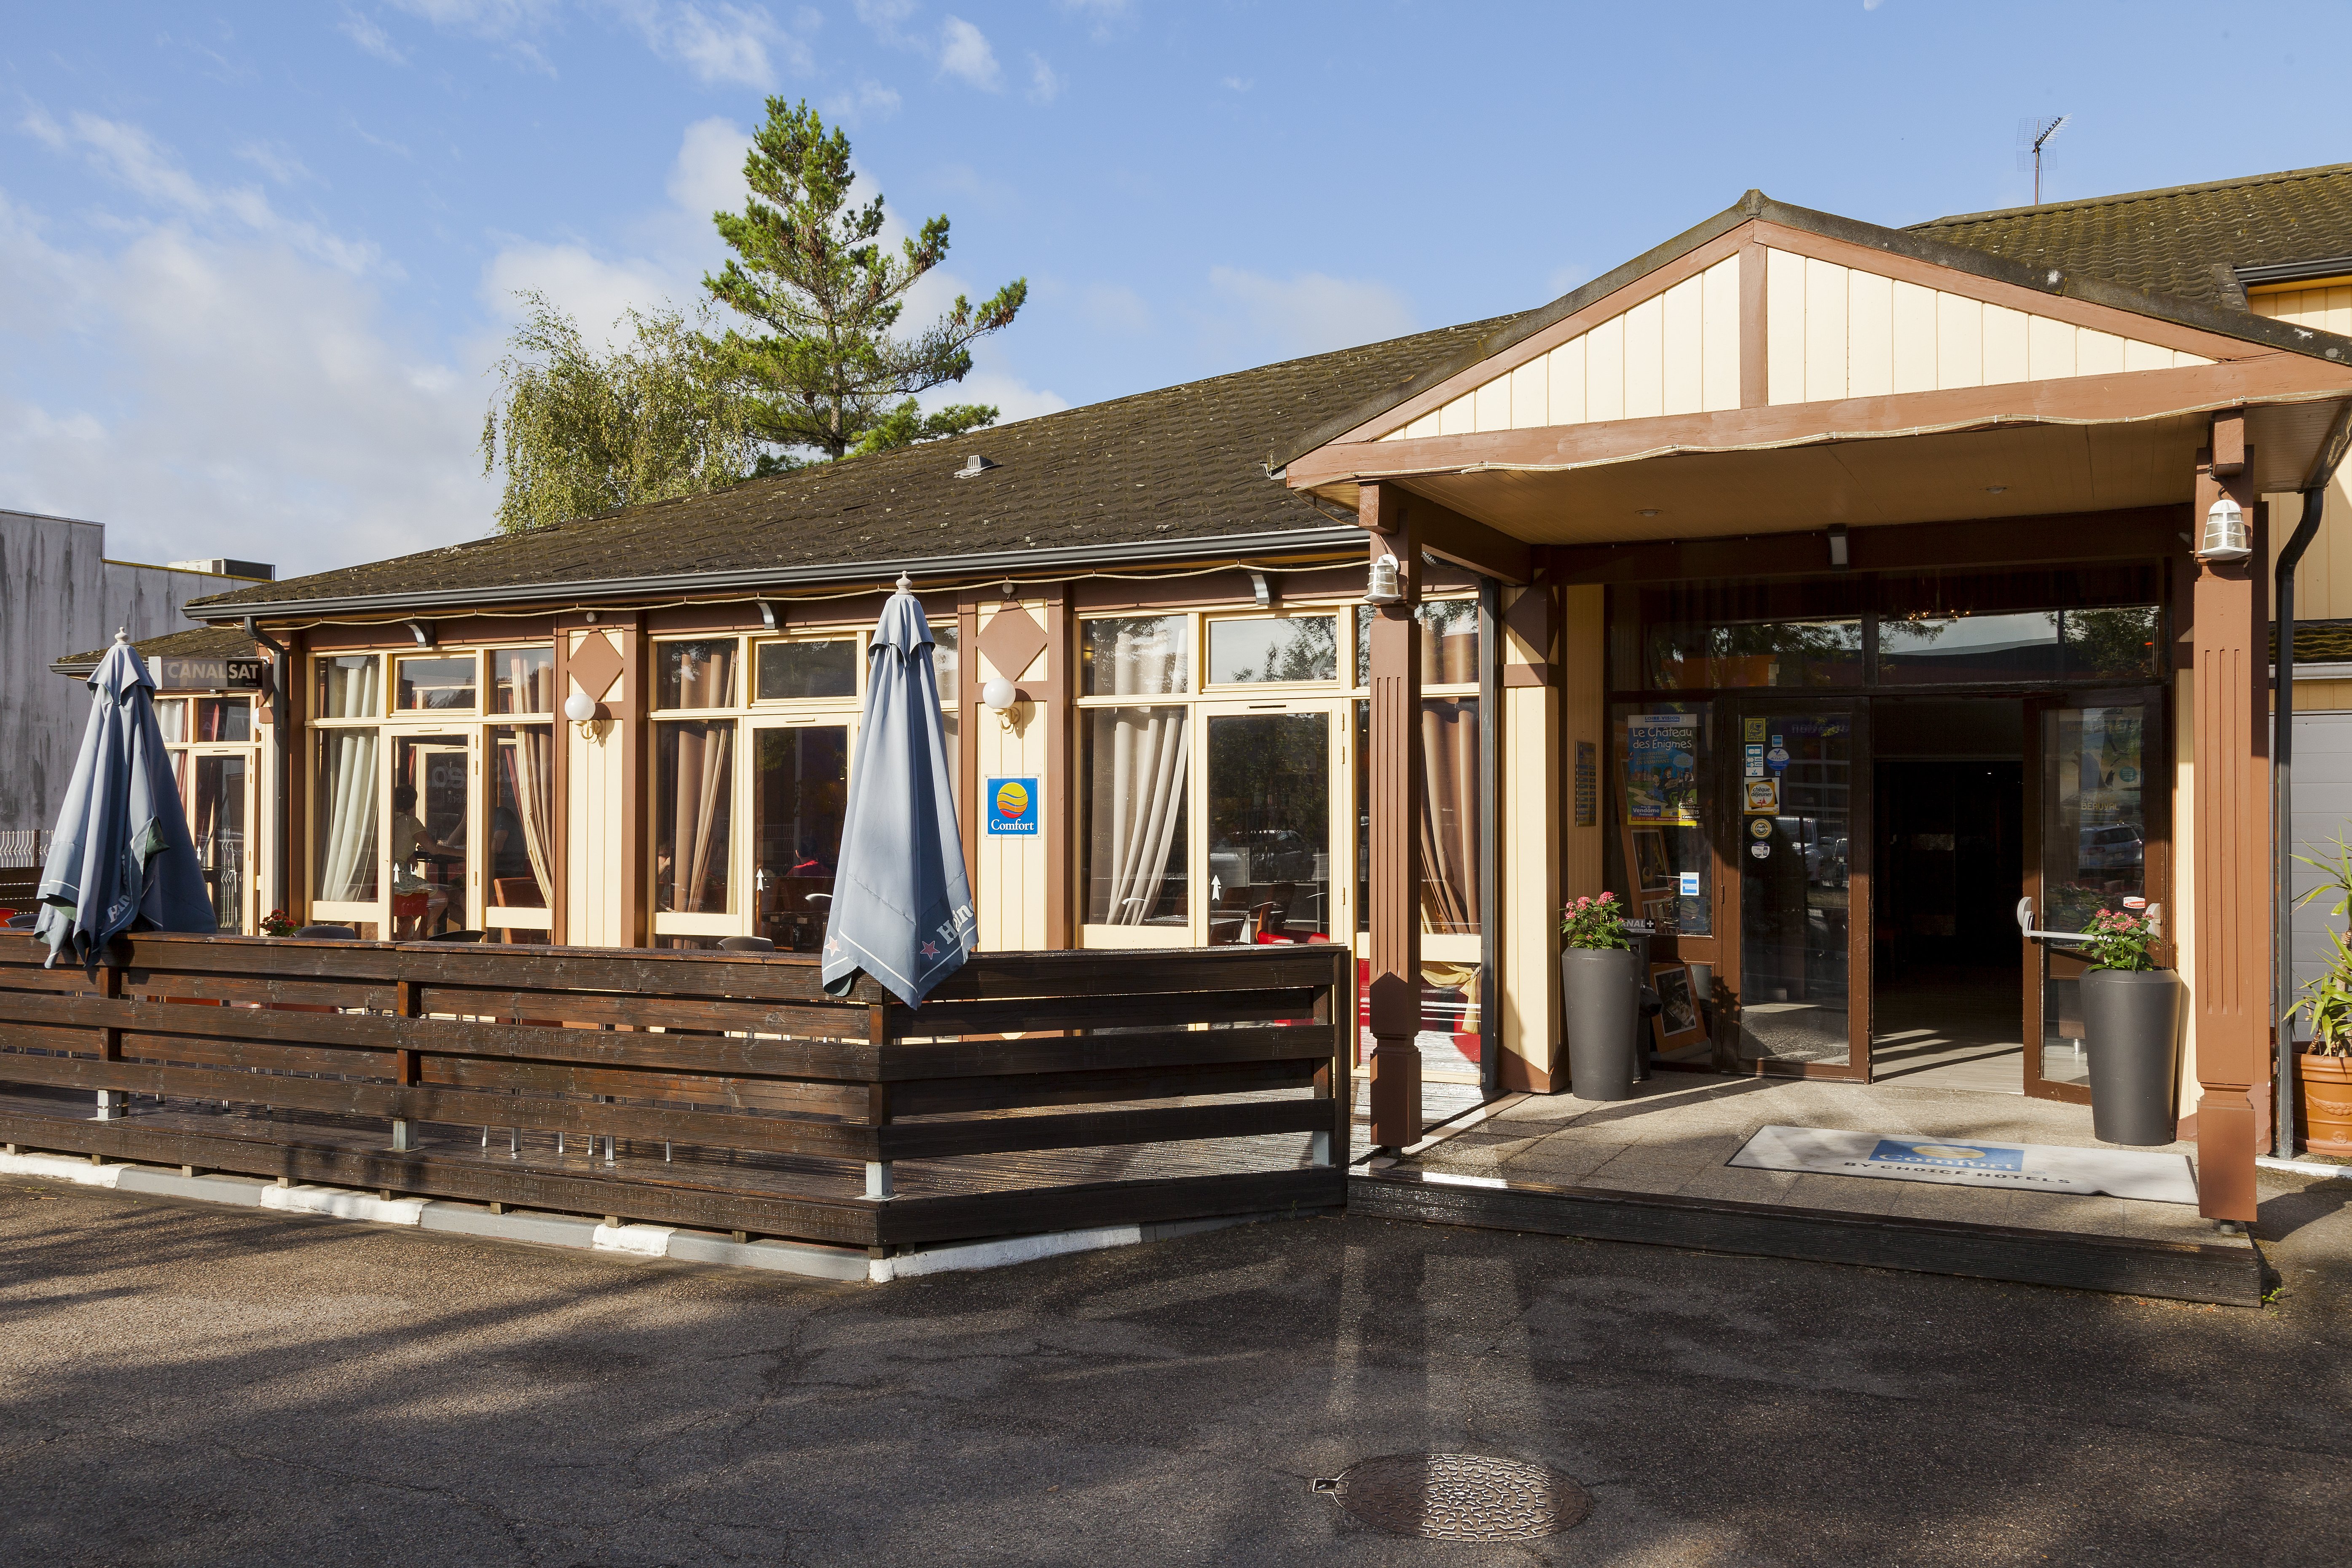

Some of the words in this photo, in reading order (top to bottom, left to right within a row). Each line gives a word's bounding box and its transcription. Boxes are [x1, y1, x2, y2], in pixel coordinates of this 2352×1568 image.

[168, 663, 258, 679] CANALSAT
[1633, 728, 1645, 737] Le
[1648, 727, 1692, 737] Château
[1633, 740, 1650, 748] des
[1652, 737, 1692, 750] Énigmes
[2081, 802, 2120, 810] BEAUVAL
[991, 819, 1034, 831] Comfort
[1879, 1154, 2016, 1170] Comfort
[1880, 1165, 1968, 1175] CHOICE
[1977, 1173, 2070, 1183] HOTELS
